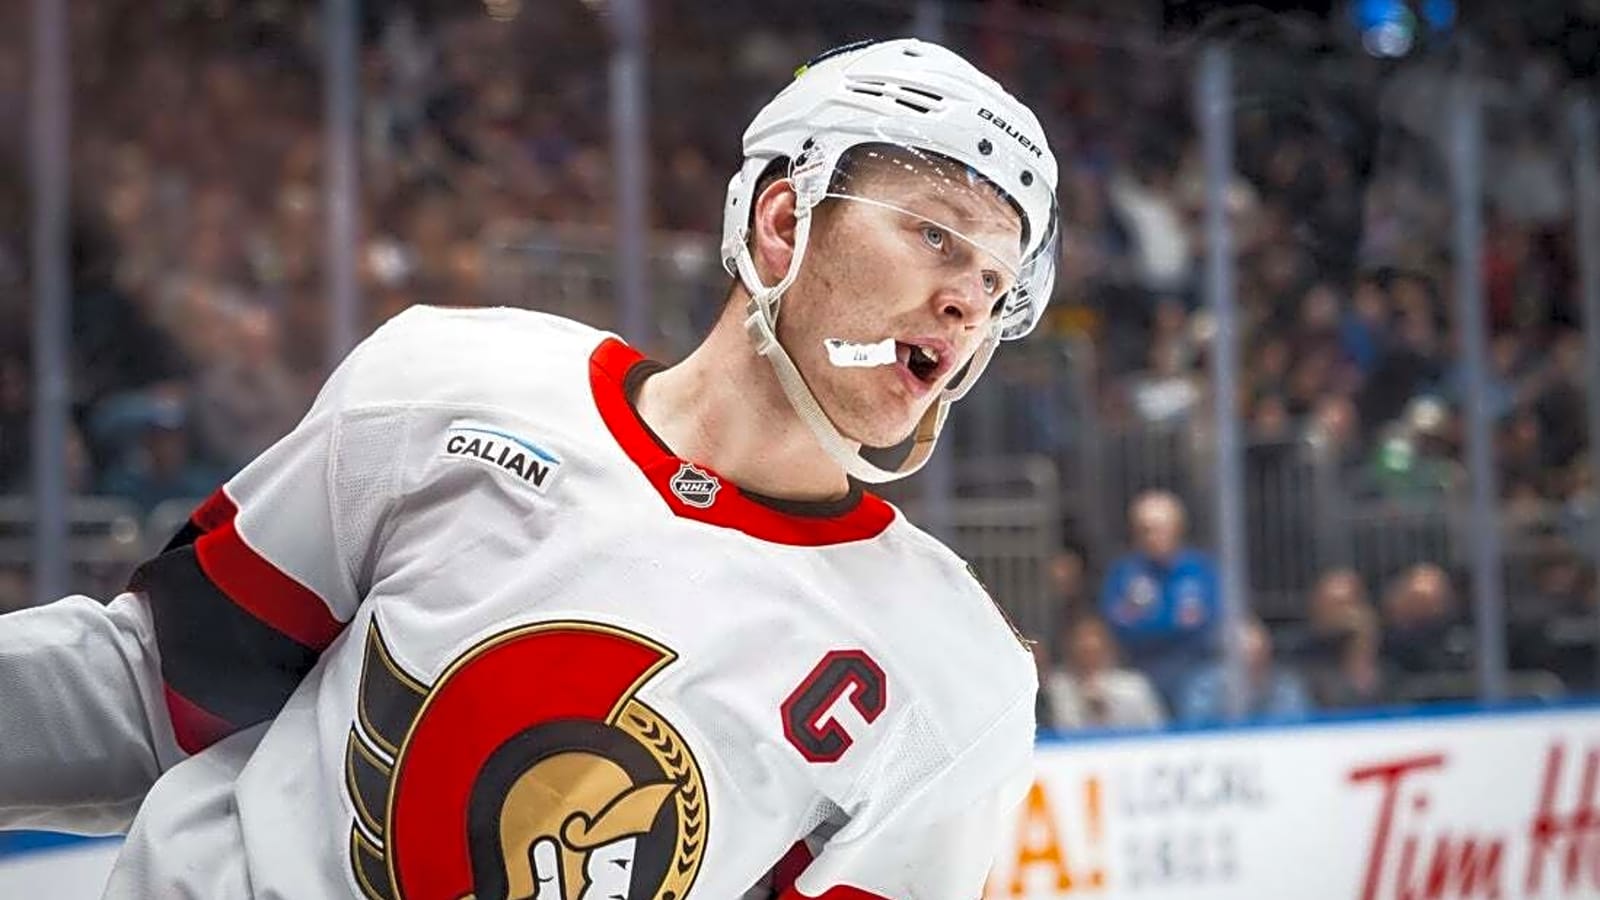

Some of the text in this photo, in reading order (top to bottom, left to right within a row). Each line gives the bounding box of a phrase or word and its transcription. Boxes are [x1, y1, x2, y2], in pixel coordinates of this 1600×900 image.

[446, 436, 549, 487] CALIAN
[679, 483, 710, 492] NHL
[780, 649, 887, 763] C
[1347, 752, 1506, 900] Tim
